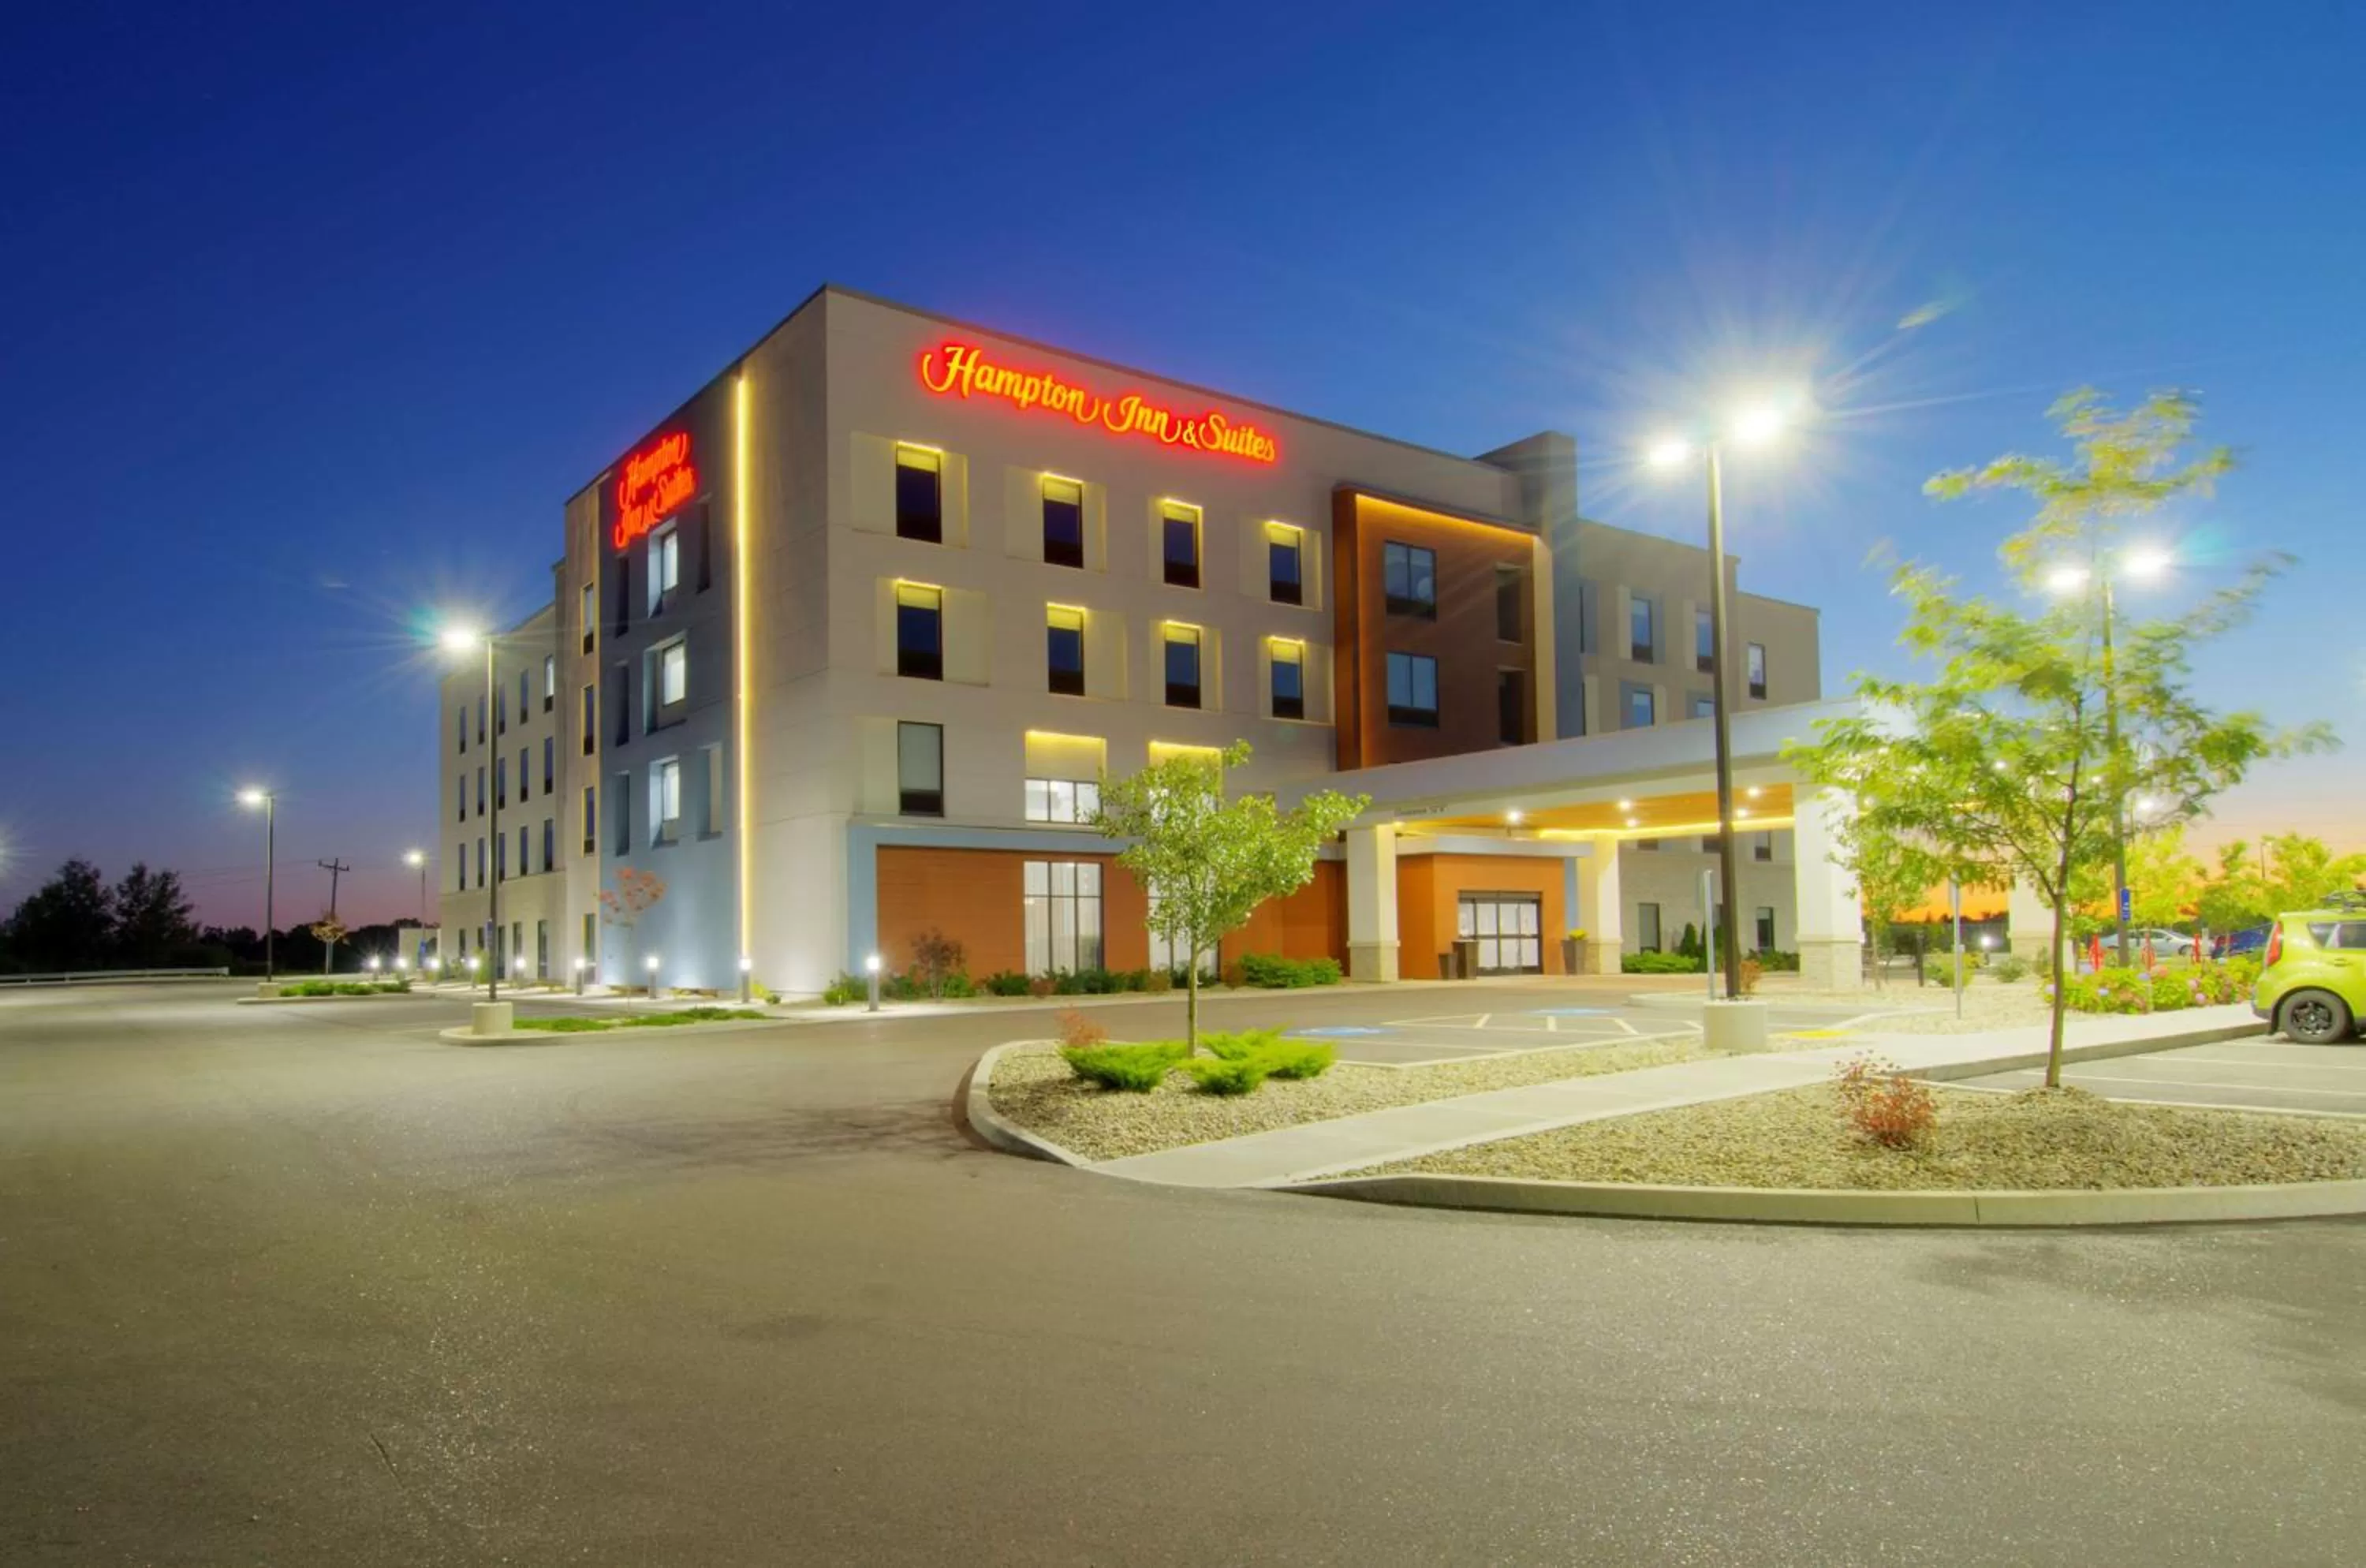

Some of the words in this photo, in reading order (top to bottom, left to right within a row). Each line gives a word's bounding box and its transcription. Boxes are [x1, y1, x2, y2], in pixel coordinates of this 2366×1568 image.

[923, 345, 1099, 424] Hampton
[1103, 396, 1181, 443] Inn
[1182, 420, 1200, 450] &
[1199, 413, 1275, 463] Suites
